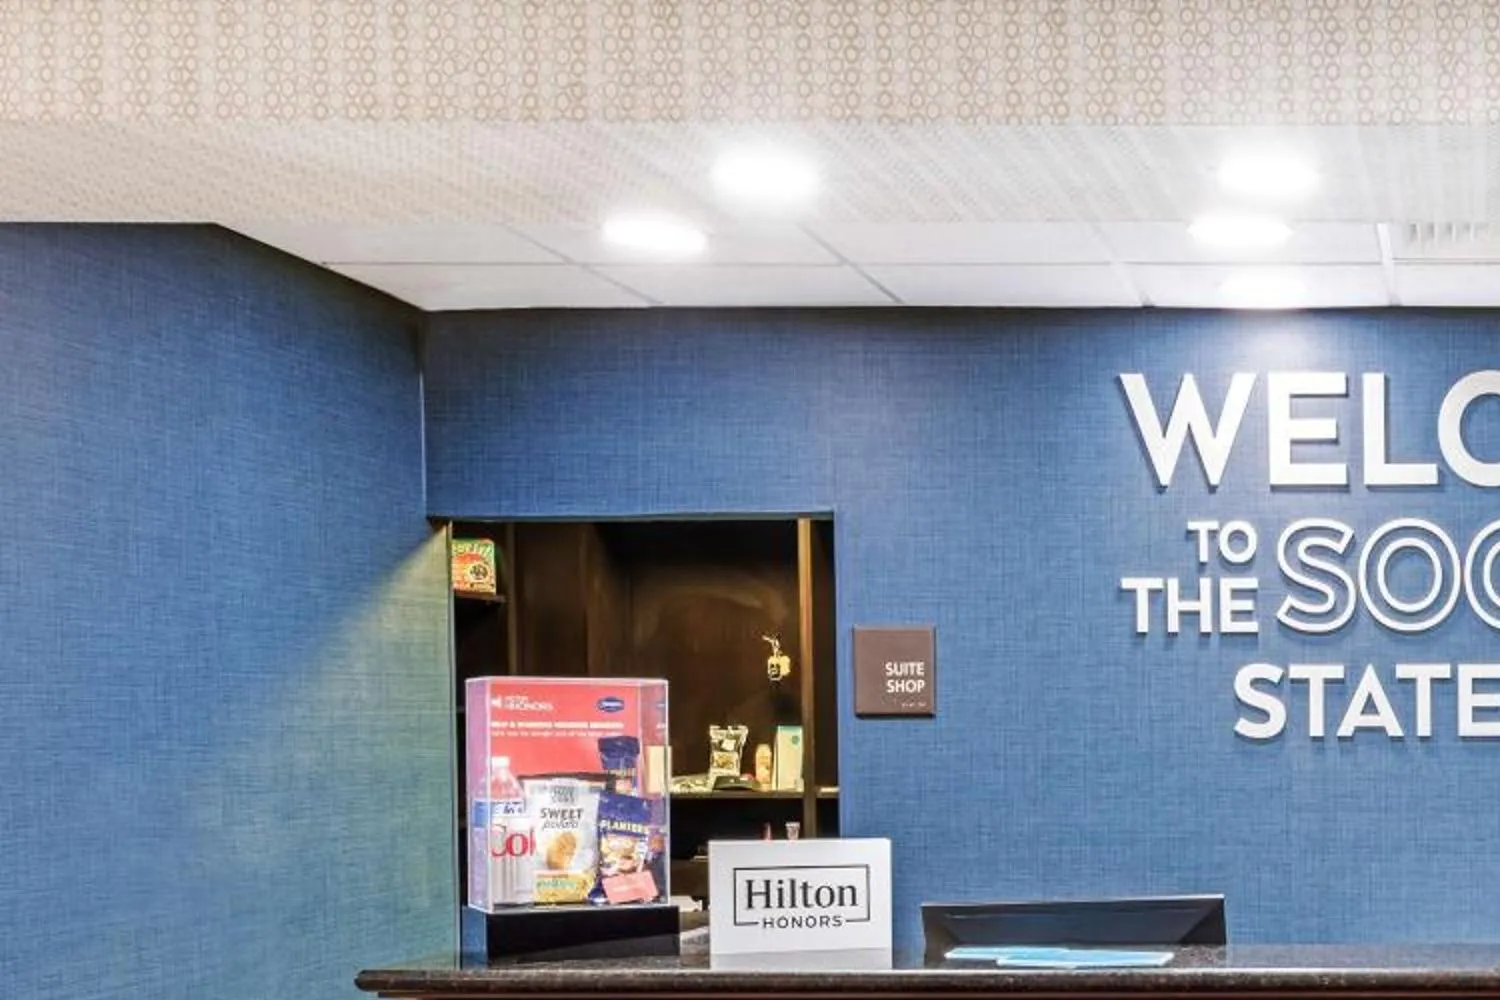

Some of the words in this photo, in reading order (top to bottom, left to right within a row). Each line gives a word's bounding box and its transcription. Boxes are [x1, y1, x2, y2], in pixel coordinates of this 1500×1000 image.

[1187, 519, 1258, 564] TO
[1121, 576, 1260, 634] THE
[885, 661, 925, 677] SUITE
[886, 679, 925, 693] SHOP
[540, 807, 584, 820] SWEET
[745, 878, 858, 909] Hilton
[762, 915, 843, 929] HONORS
